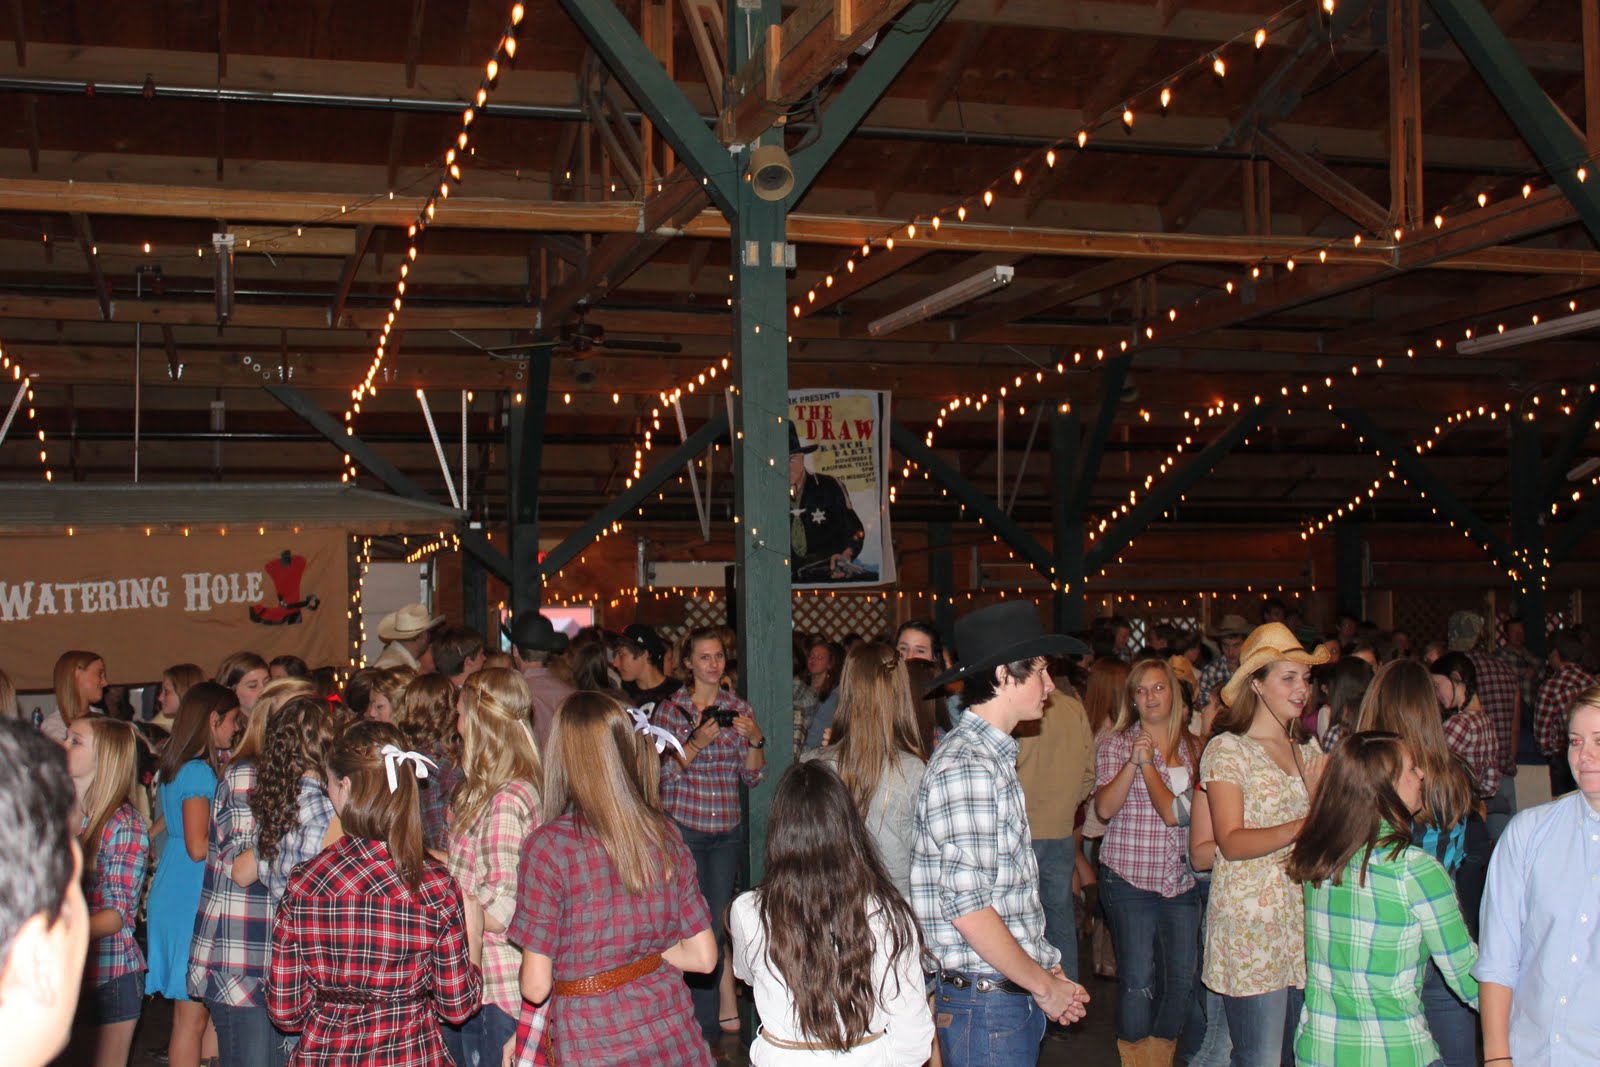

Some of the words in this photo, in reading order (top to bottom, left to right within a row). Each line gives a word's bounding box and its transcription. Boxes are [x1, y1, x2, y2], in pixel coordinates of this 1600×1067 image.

[800, 391, 840, 404] PRESENTS
[795, 405, 832, 420] THE
[805, 419, 874, 440] DRAW
[820, 441, 863, 452] RANCH
[834, 447, 873, 457] PARTY
[0, 576, 170, 621] WATERING
[182, 571, 264, 612] HOLE
